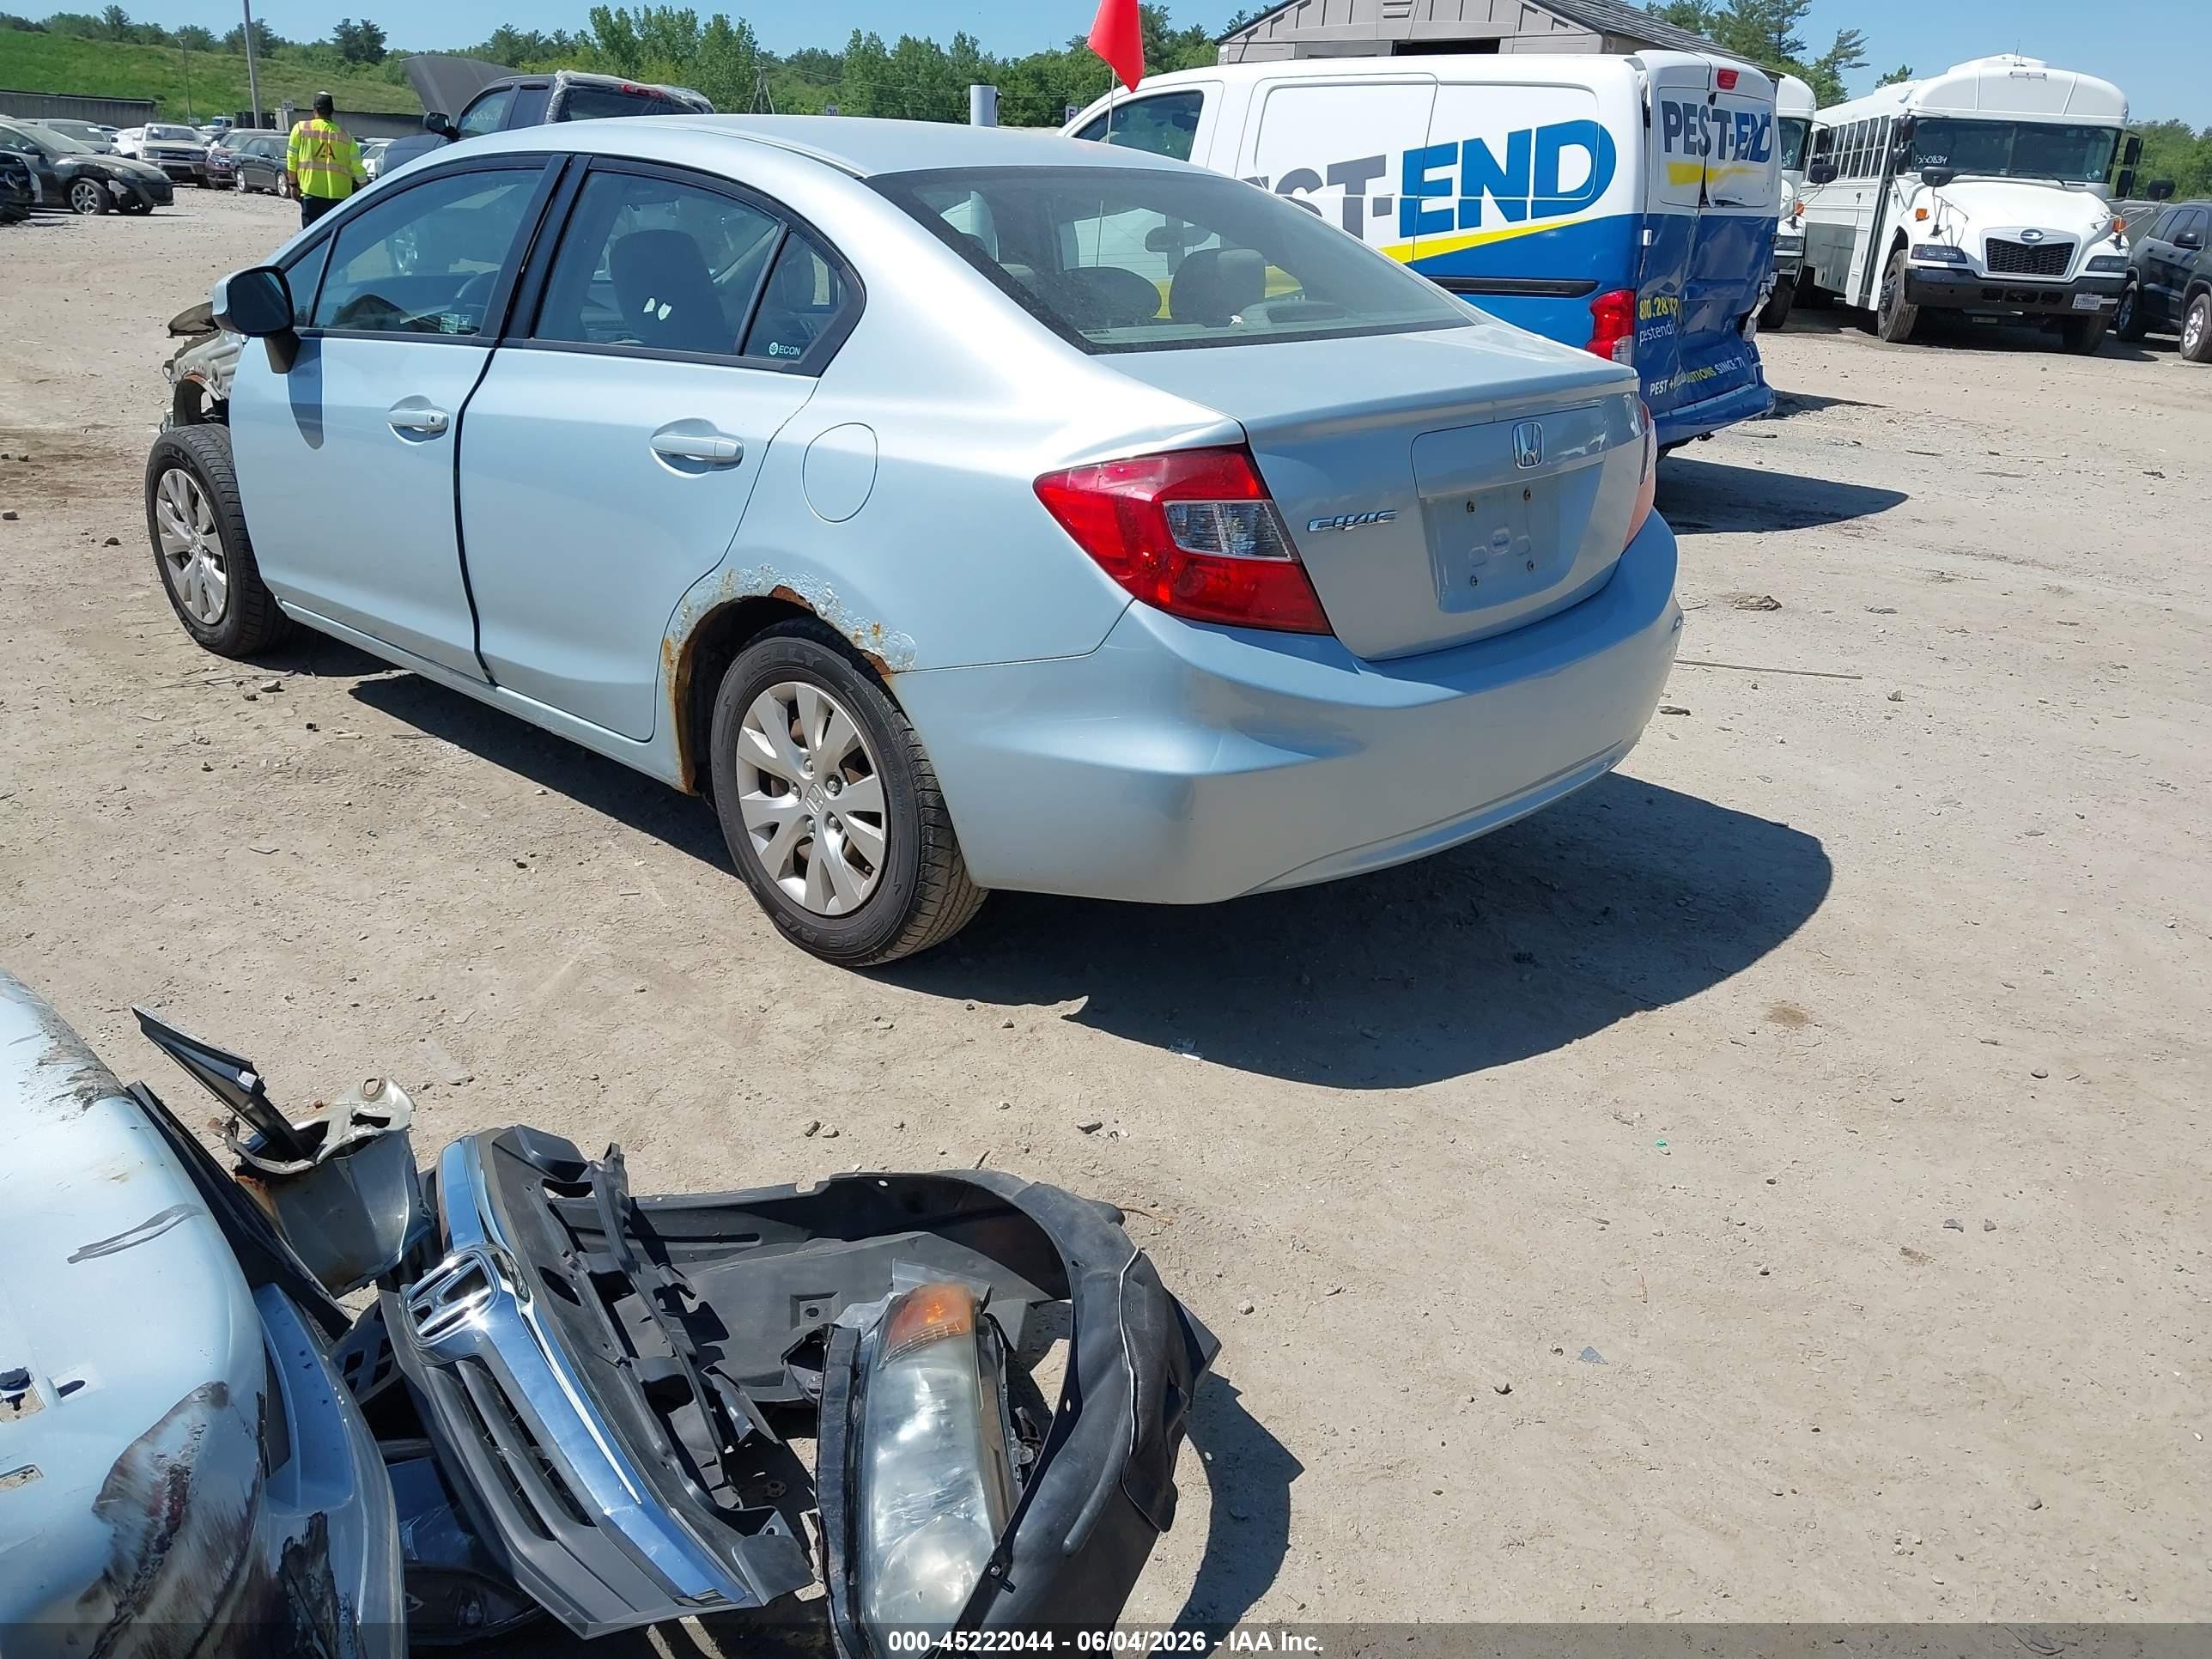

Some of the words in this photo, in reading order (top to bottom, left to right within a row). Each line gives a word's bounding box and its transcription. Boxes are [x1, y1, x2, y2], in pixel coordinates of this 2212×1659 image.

[778, 344, 801, 356] ECON
[1649, 379, 1669, 397] PEST
[1714, 358, 1738, 375] SINCE
[1307, 509, 1398, 532] CIVIC
